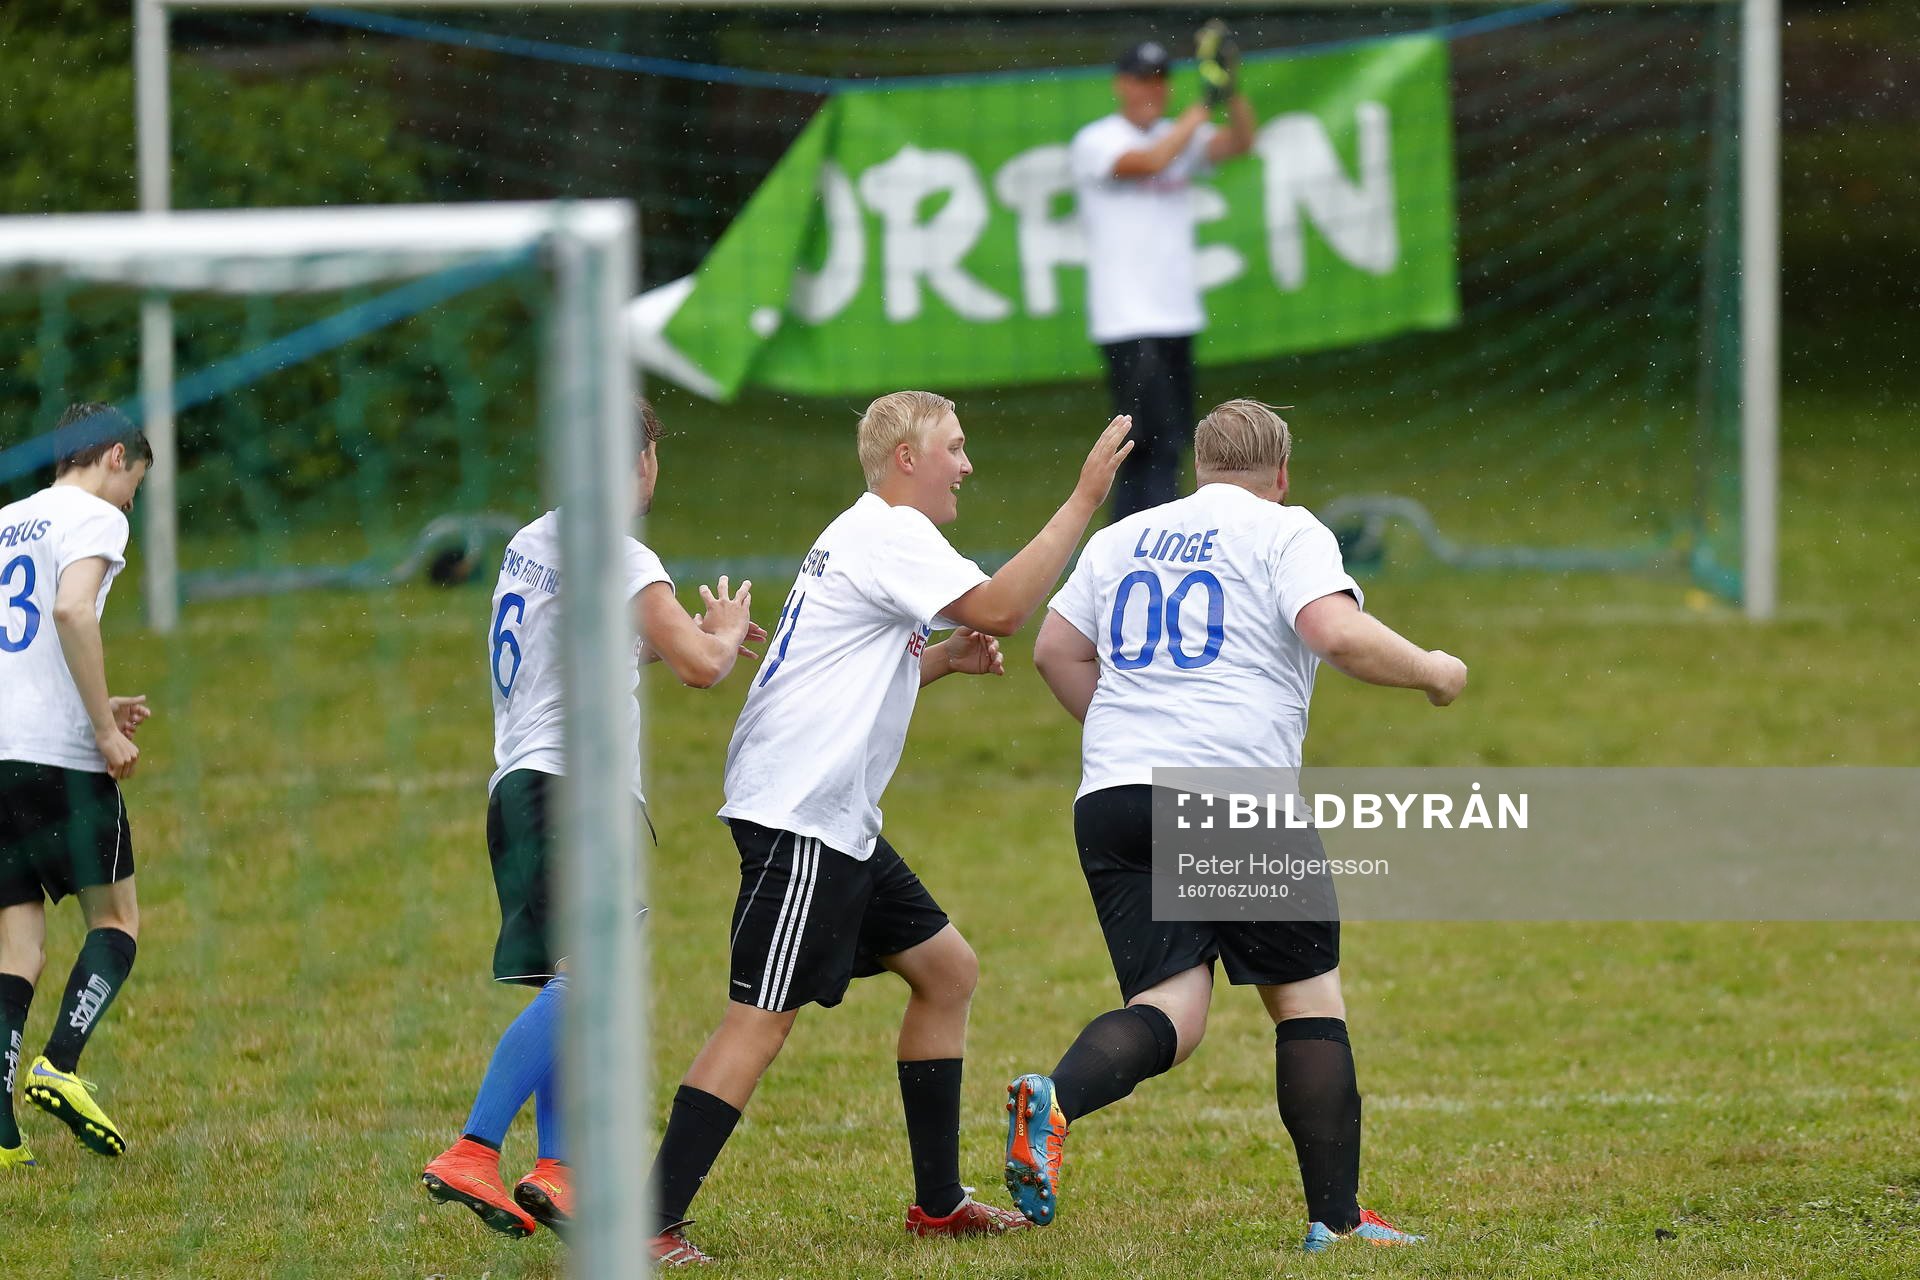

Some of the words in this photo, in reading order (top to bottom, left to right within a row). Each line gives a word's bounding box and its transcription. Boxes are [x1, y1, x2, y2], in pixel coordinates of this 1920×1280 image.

[1134, 528, 1218, 563] LINGE
[492, 592, 526, 699] 6
[1110, 569, 1225, 671] 00
